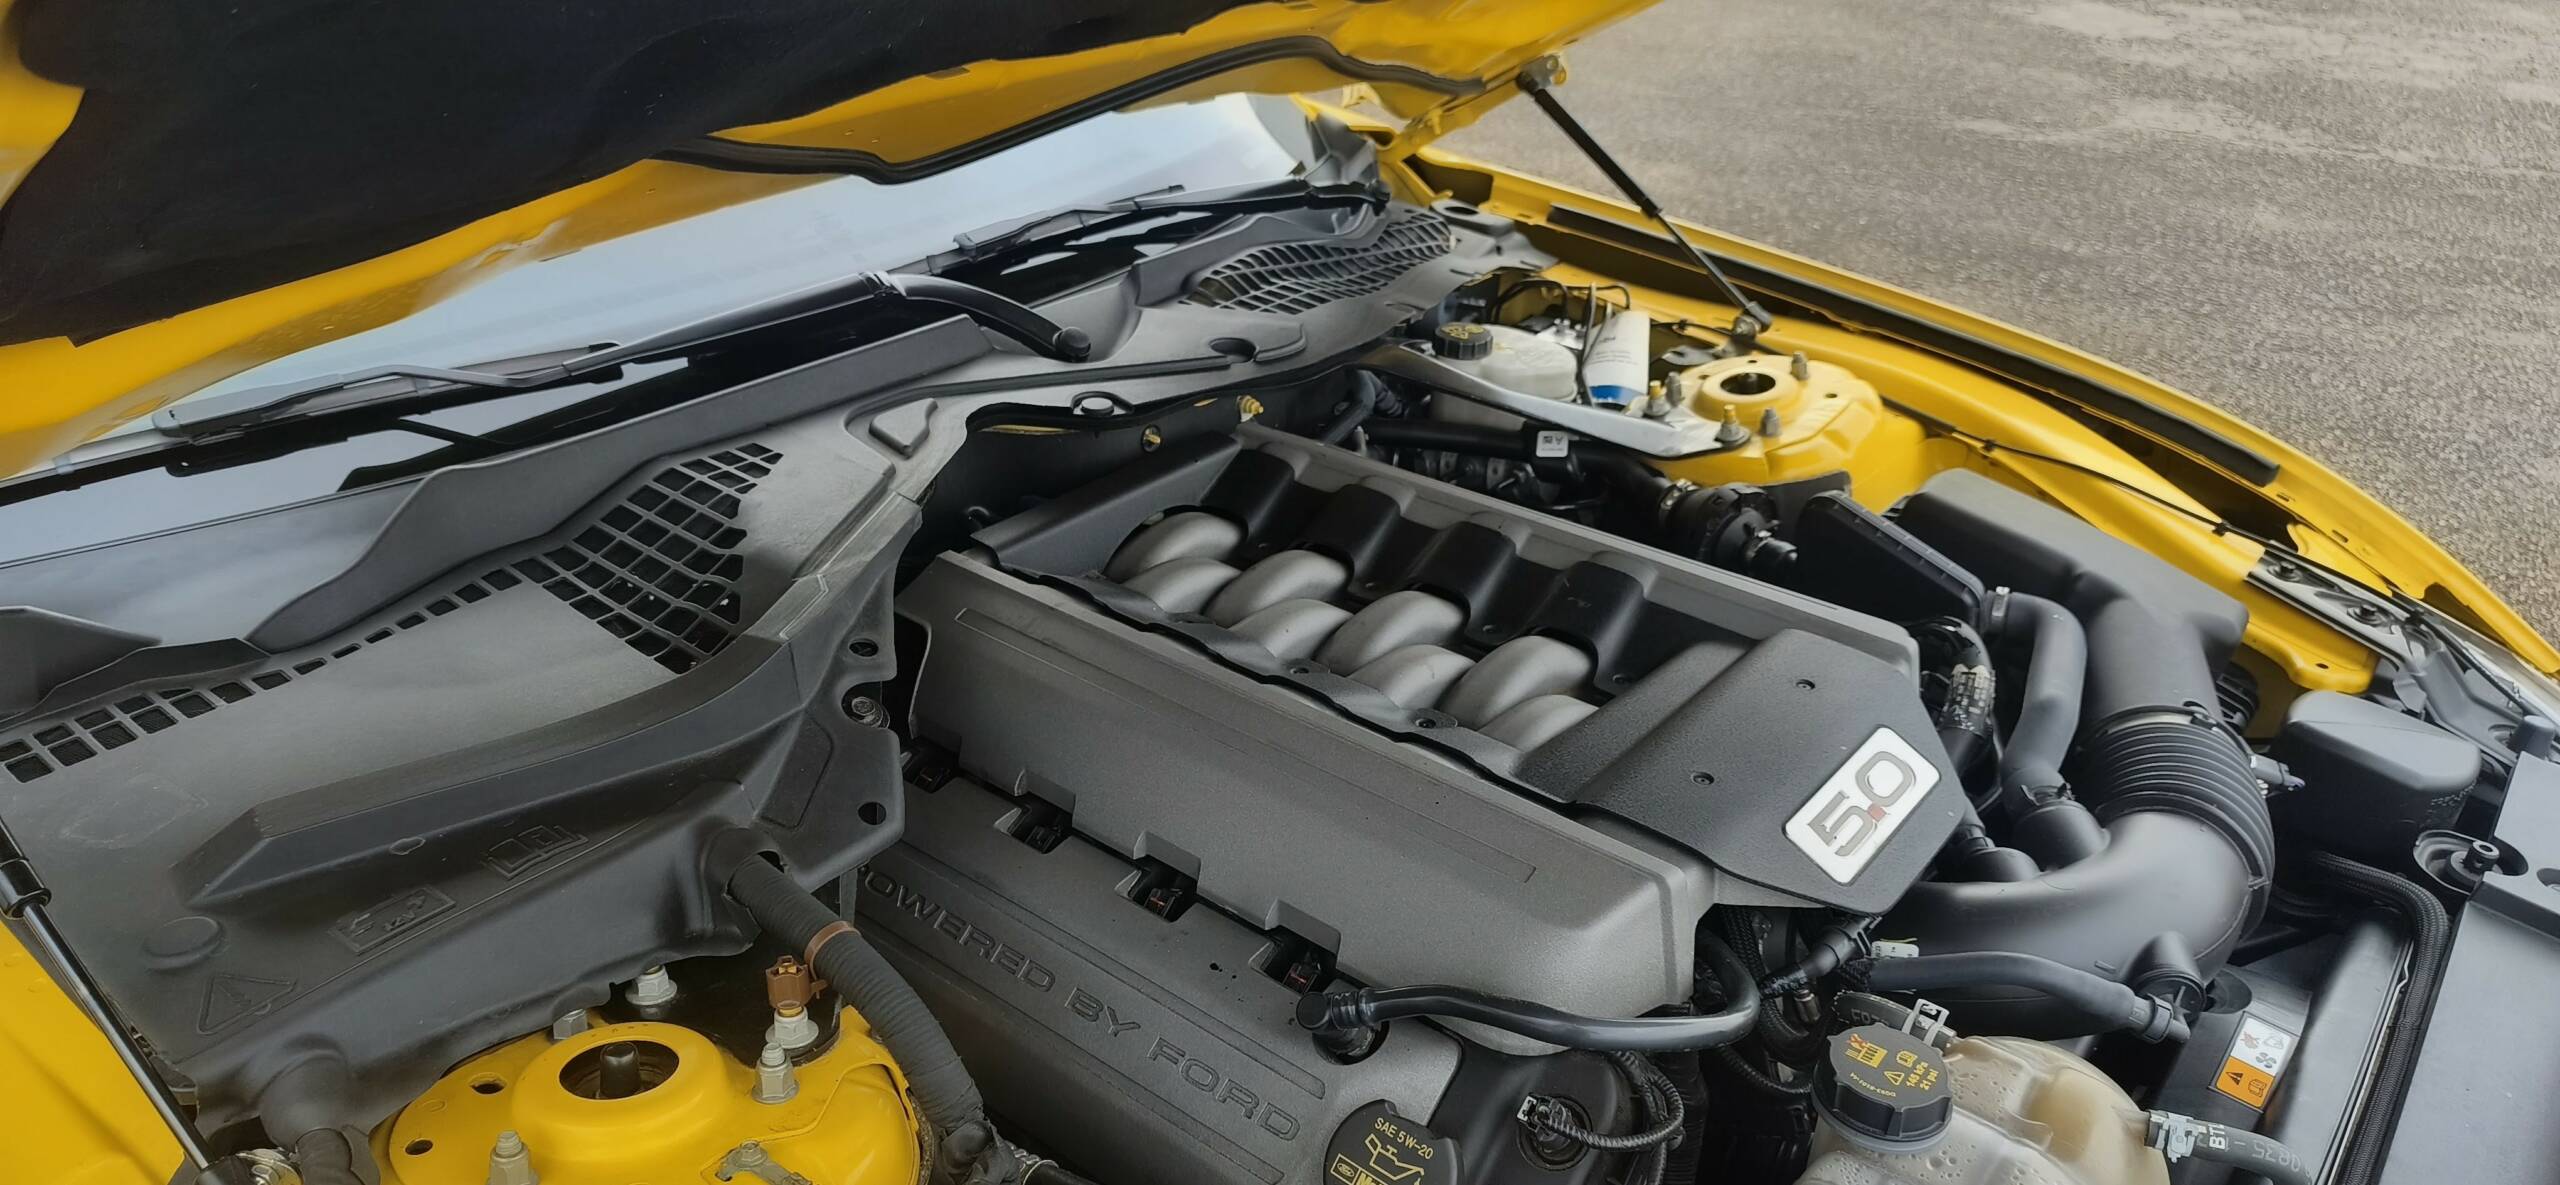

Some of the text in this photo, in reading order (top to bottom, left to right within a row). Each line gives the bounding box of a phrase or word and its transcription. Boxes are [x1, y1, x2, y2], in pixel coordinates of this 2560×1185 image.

[1807, 750, 1917, 857] 5.0
[858, 866, 1302, 1142] OWERED BY FORD
[1374, 1117, 1434, 1160] SAE 5W-20
